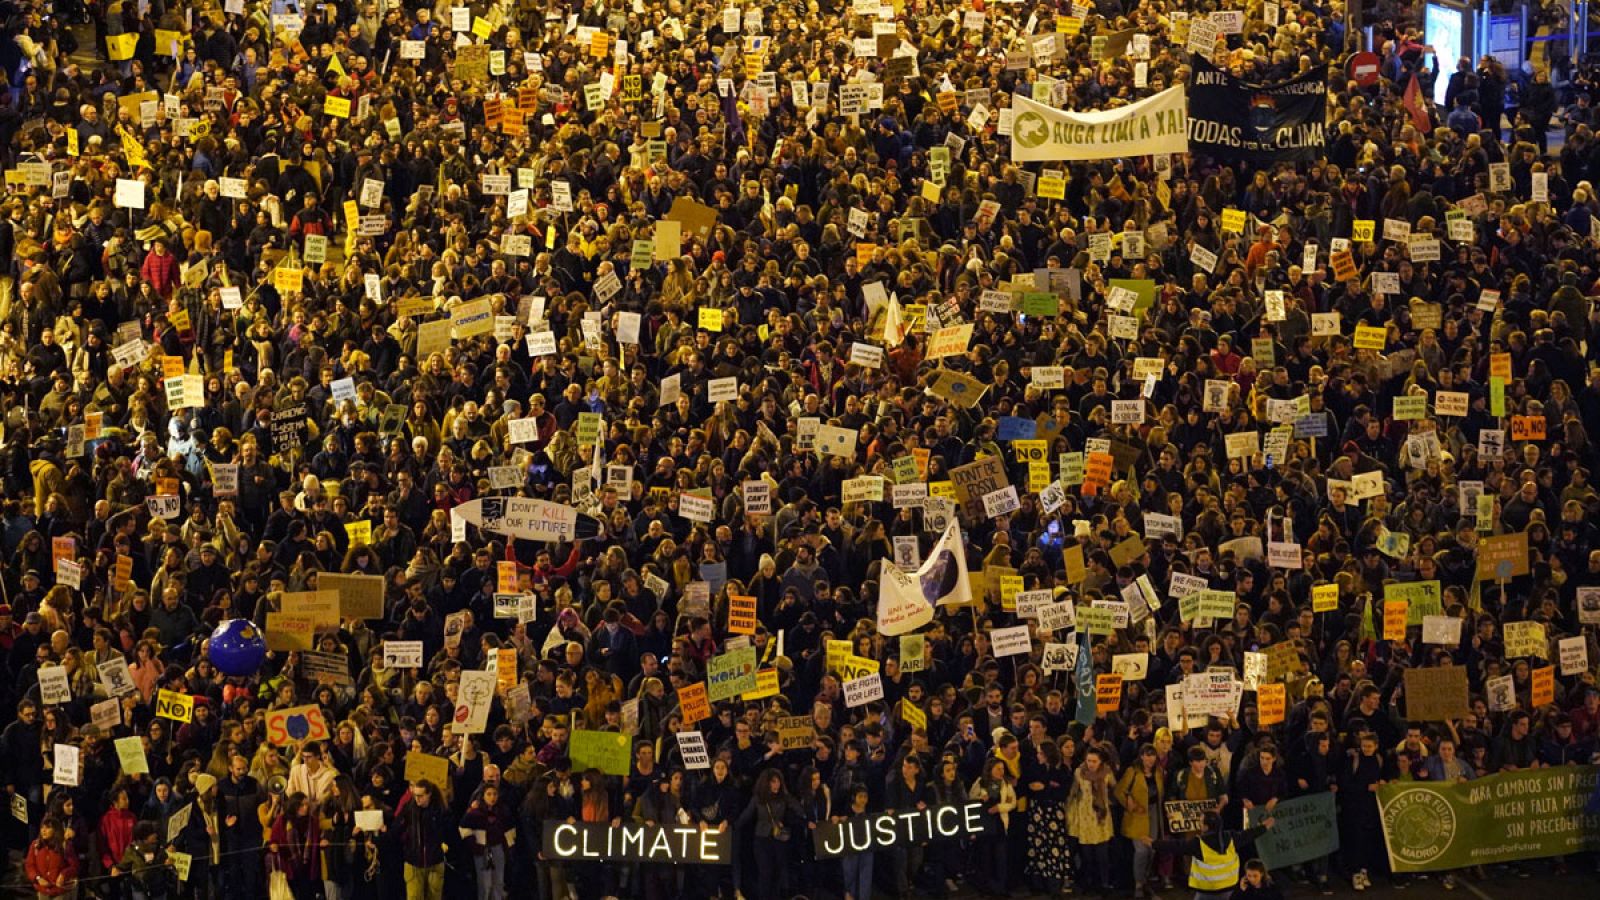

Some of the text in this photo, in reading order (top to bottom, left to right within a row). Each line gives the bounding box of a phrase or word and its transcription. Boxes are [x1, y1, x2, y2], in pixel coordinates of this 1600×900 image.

[1196, 71, 1228, 86] ANTE
[1053, 122, 1095, 144] AUGA
[1155, 109, 1184, 136] XA!
[1187, 117, 1241, 148] TODAS
[1276, 122, 1325, 149] CLIMA
[542, 504, 568, 521] KILL
[506, 518, 524, 528] OUR
[846, 684, 859, 694] WE
[846, 687, 882, 703] FOR LIFE!
[155, 700, 193, 721] NO!
[269, 709, 326, 745] SOS
[779, 719, 813, 730] SILENC
[780, 737, 811, 748] OPTIO
[1469, 788, 1492, 805] PARA
[1496, 777, 1542, 798] CAMBIOS
[1547, 776, 1565, 792] SIN
[1167, 803, 1182, 813] THE
[1493, 801, 1525, 819] HACEN
[1530, 797, 1558, 815] FALTA
[823, 802, 986, 855] JUSTICE
[1506, 814, 1599, 838] SIN PRECEDENTES
[553, 823, 721, 861] CLIMATE
[1400, 845, 1439, 859] MADRID
